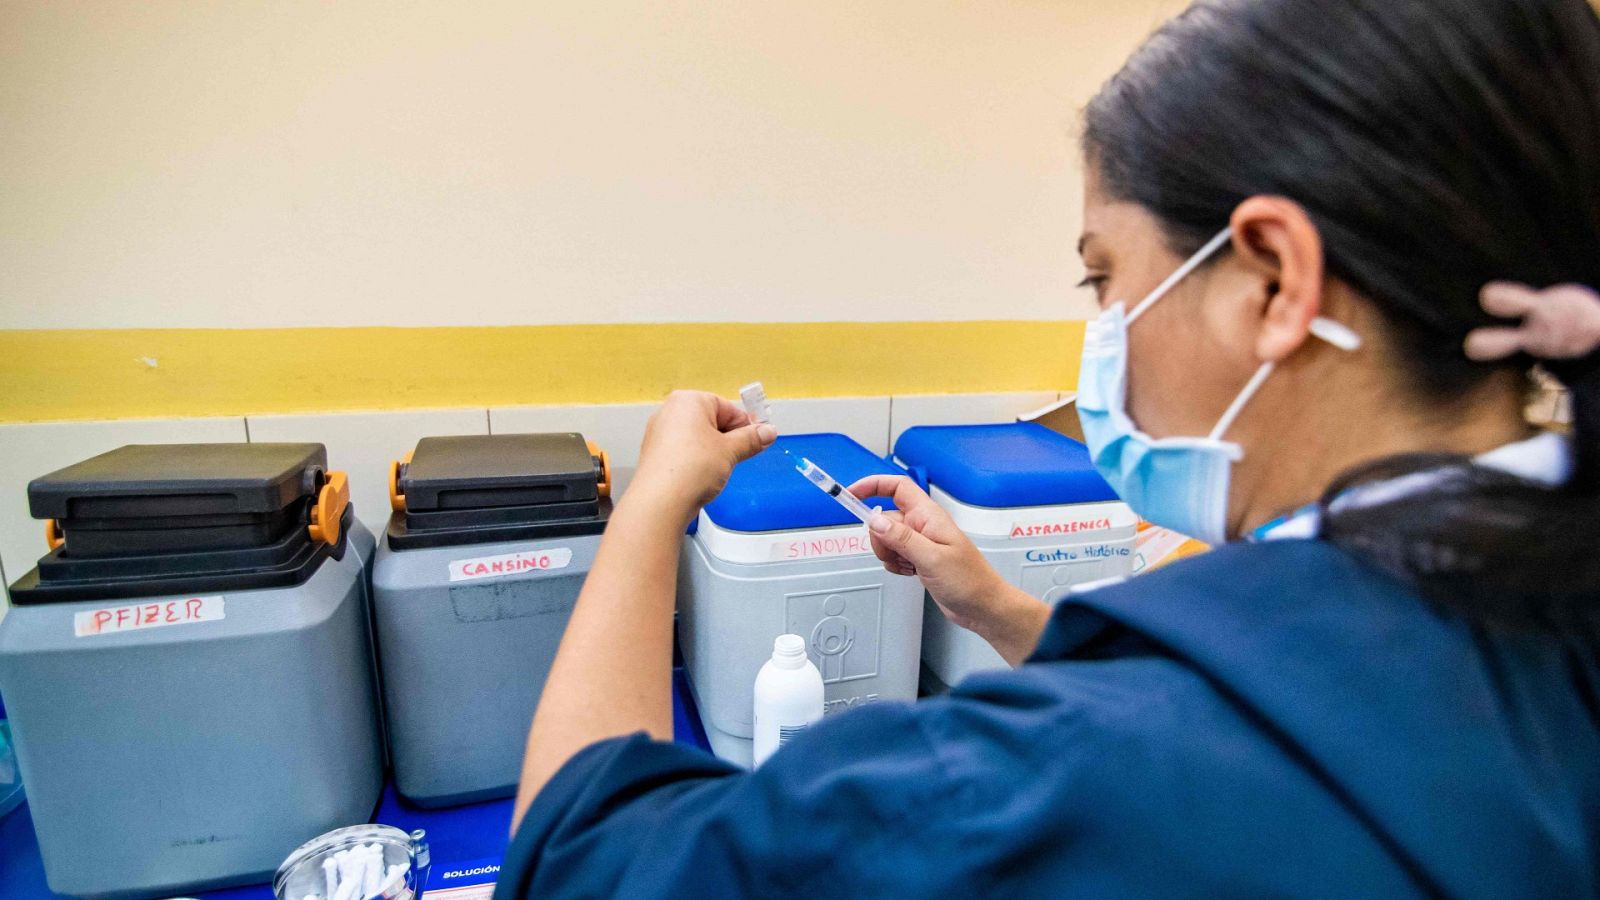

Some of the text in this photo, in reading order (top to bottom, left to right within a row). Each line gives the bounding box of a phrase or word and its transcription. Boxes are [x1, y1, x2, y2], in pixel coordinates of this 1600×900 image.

[1011, 518, 1111, 537] ASTRAZENECA
[787, 536, 869, 557] SINOVAC
[1026, 549, 1078, 562] Centro
[462, 554, 551, 576] CANSINO
[94, 598, 203, 631] PFIZER
[443, 865, 501, 879] SOLUCIÓN
